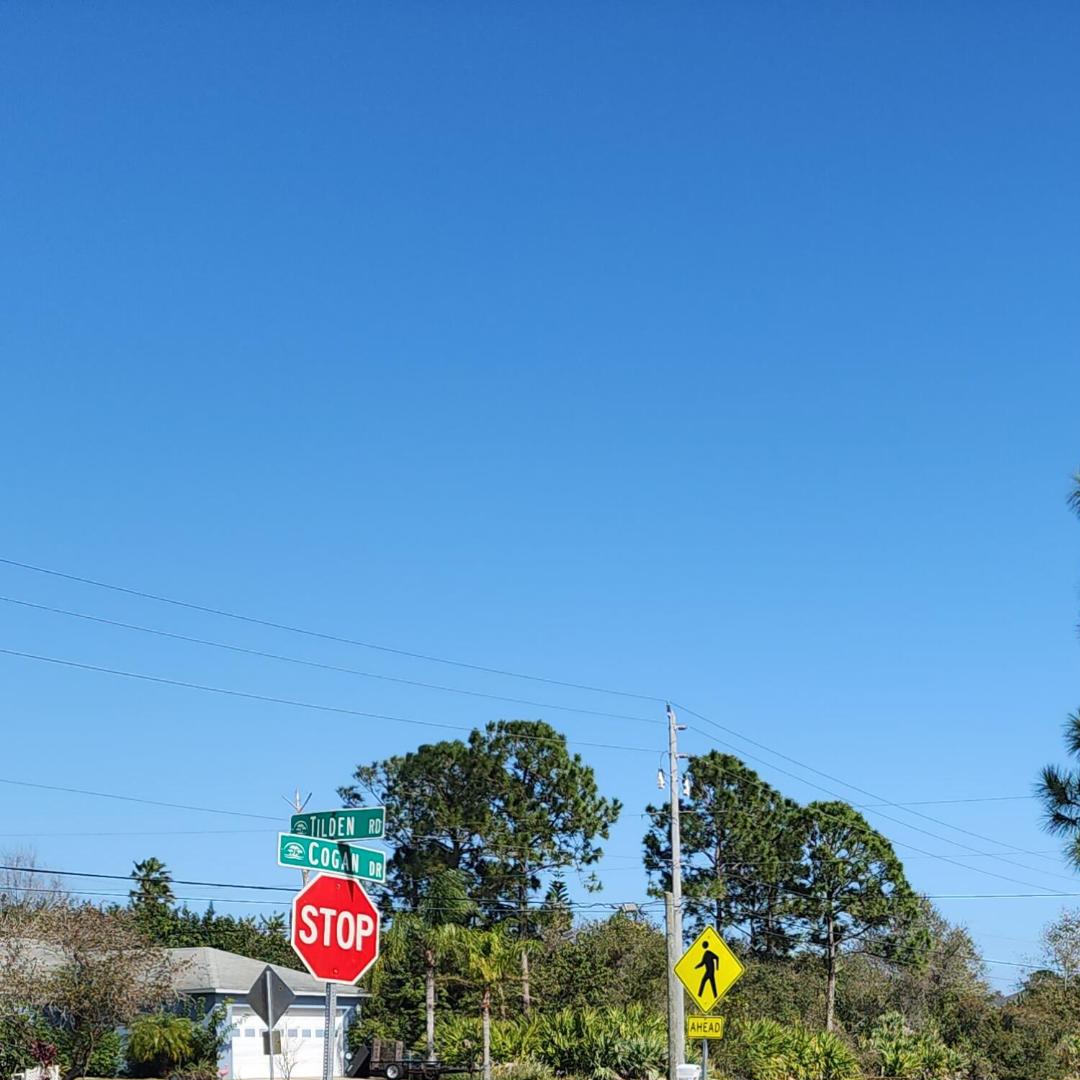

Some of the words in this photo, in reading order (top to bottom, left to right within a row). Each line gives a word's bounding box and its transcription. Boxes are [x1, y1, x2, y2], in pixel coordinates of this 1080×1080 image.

[310, 816, 355, 838] TILDEN
[368, 818, 381, 834] RD
[308, 841, 360, 873] COGAN
[369, 860, 382, 878] DR
[299, 904, 374, 952] STOP
[690, 1021, 721, 1033] AHEAD
